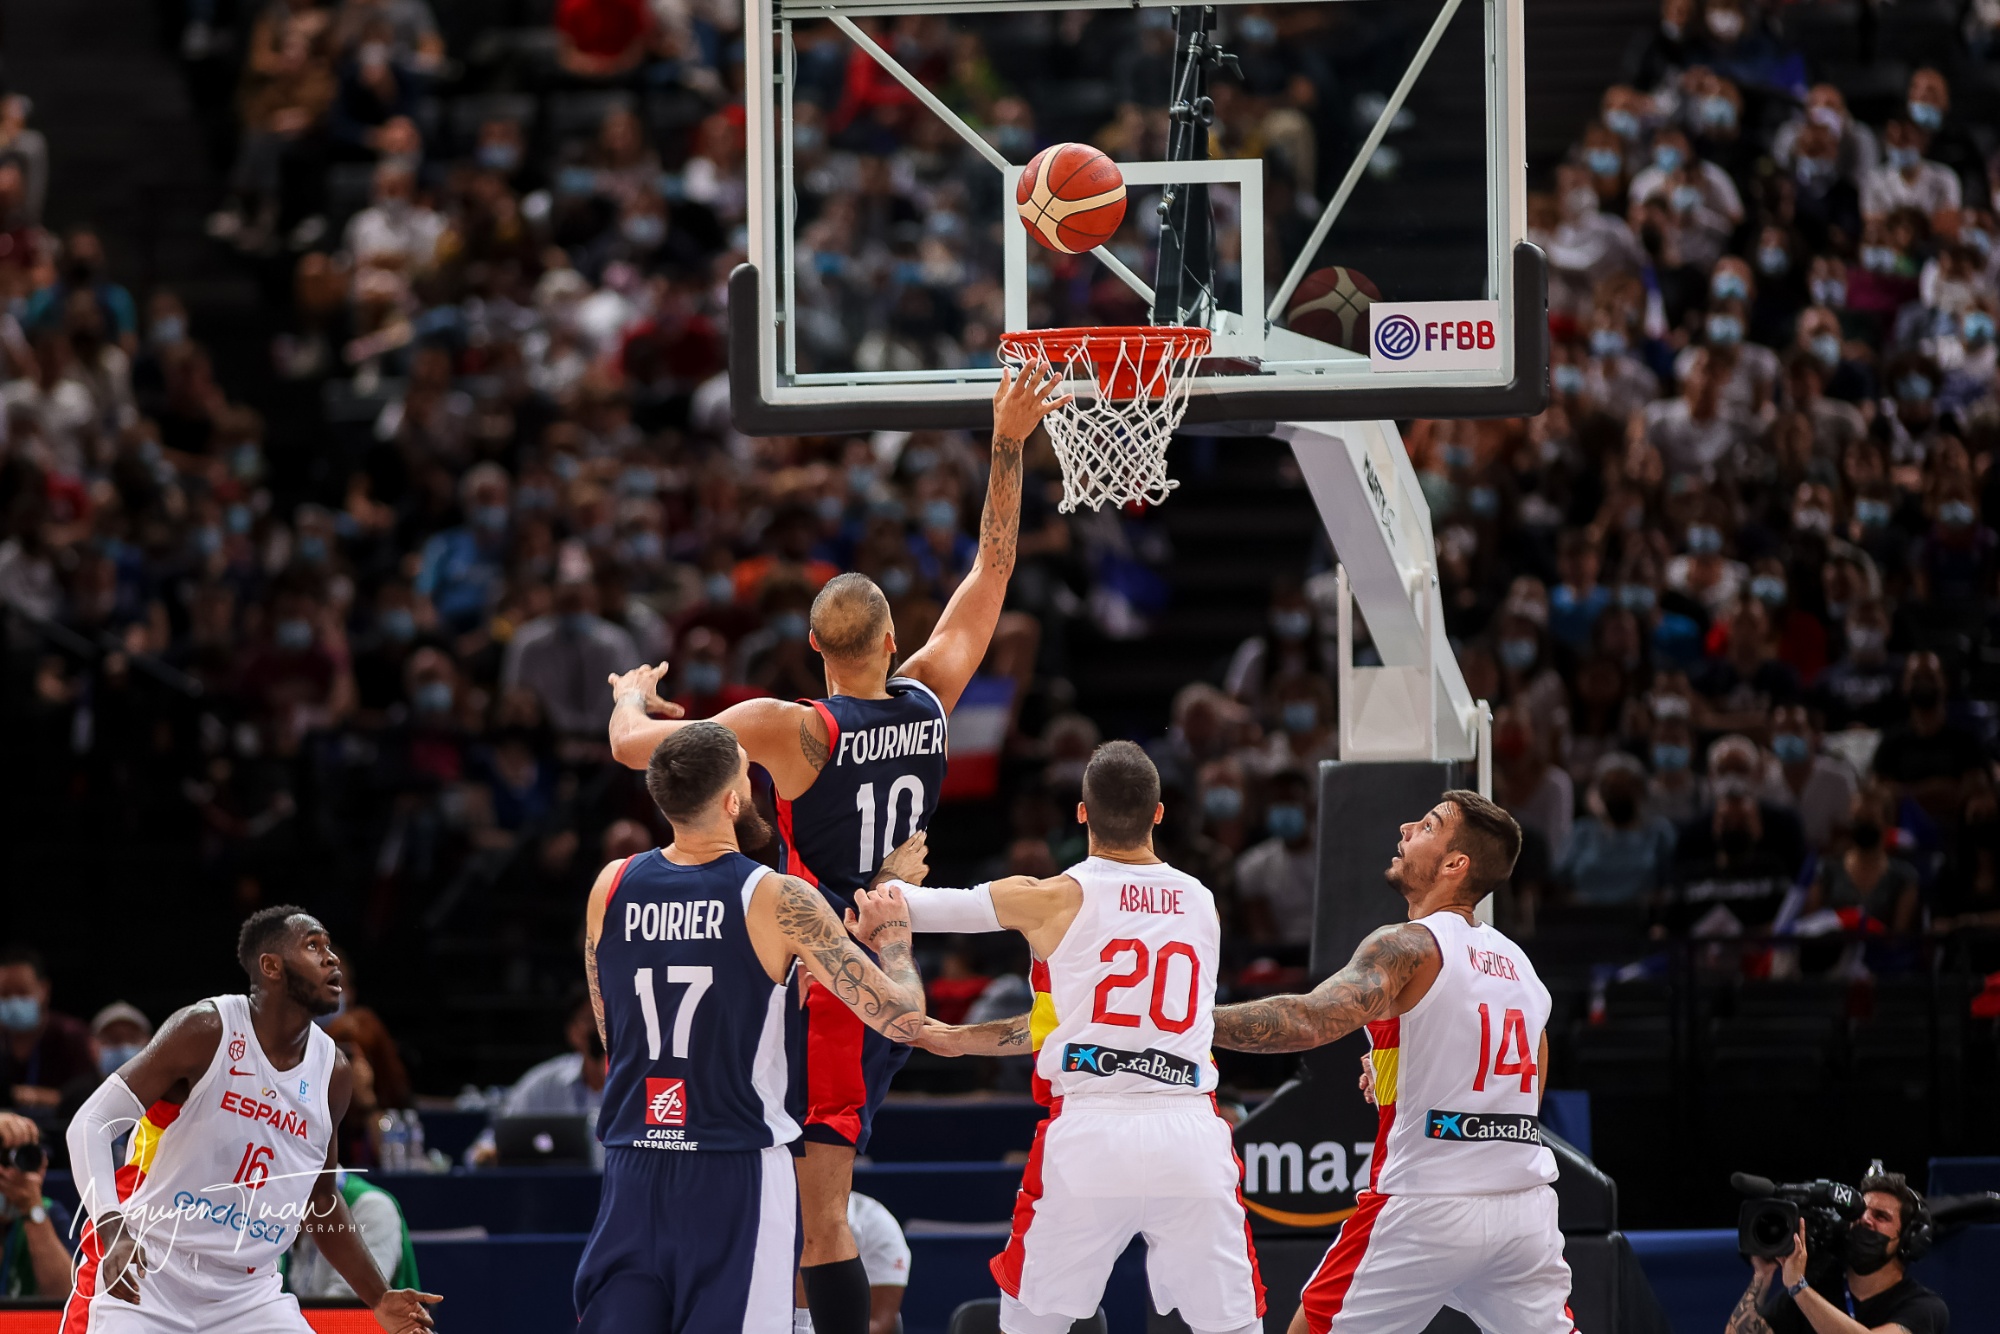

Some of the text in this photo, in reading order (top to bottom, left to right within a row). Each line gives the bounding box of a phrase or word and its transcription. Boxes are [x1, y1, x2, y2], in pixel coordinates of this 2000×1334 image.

[1424, 320, 1495, 351] FFBB
[836, 718, 943, 766] FOURNIER
[857, 774, 924, 873] 10
[625, 900, 725, 941] POIRIER
[1120, 884, 1185, 914] ABALDE
[1091, 938, 1200, 1035] 20
[634, 966, 713, 1060] 17
[1472, 1003, 1537, 1093] 14
[220, 1090, 307, 1140] ESPAÑA
[646, 1129, 685, 1140] CAISSE
[233, 1142, 275, 1190] 16
[174, 1191, 285, 1244] endesa
